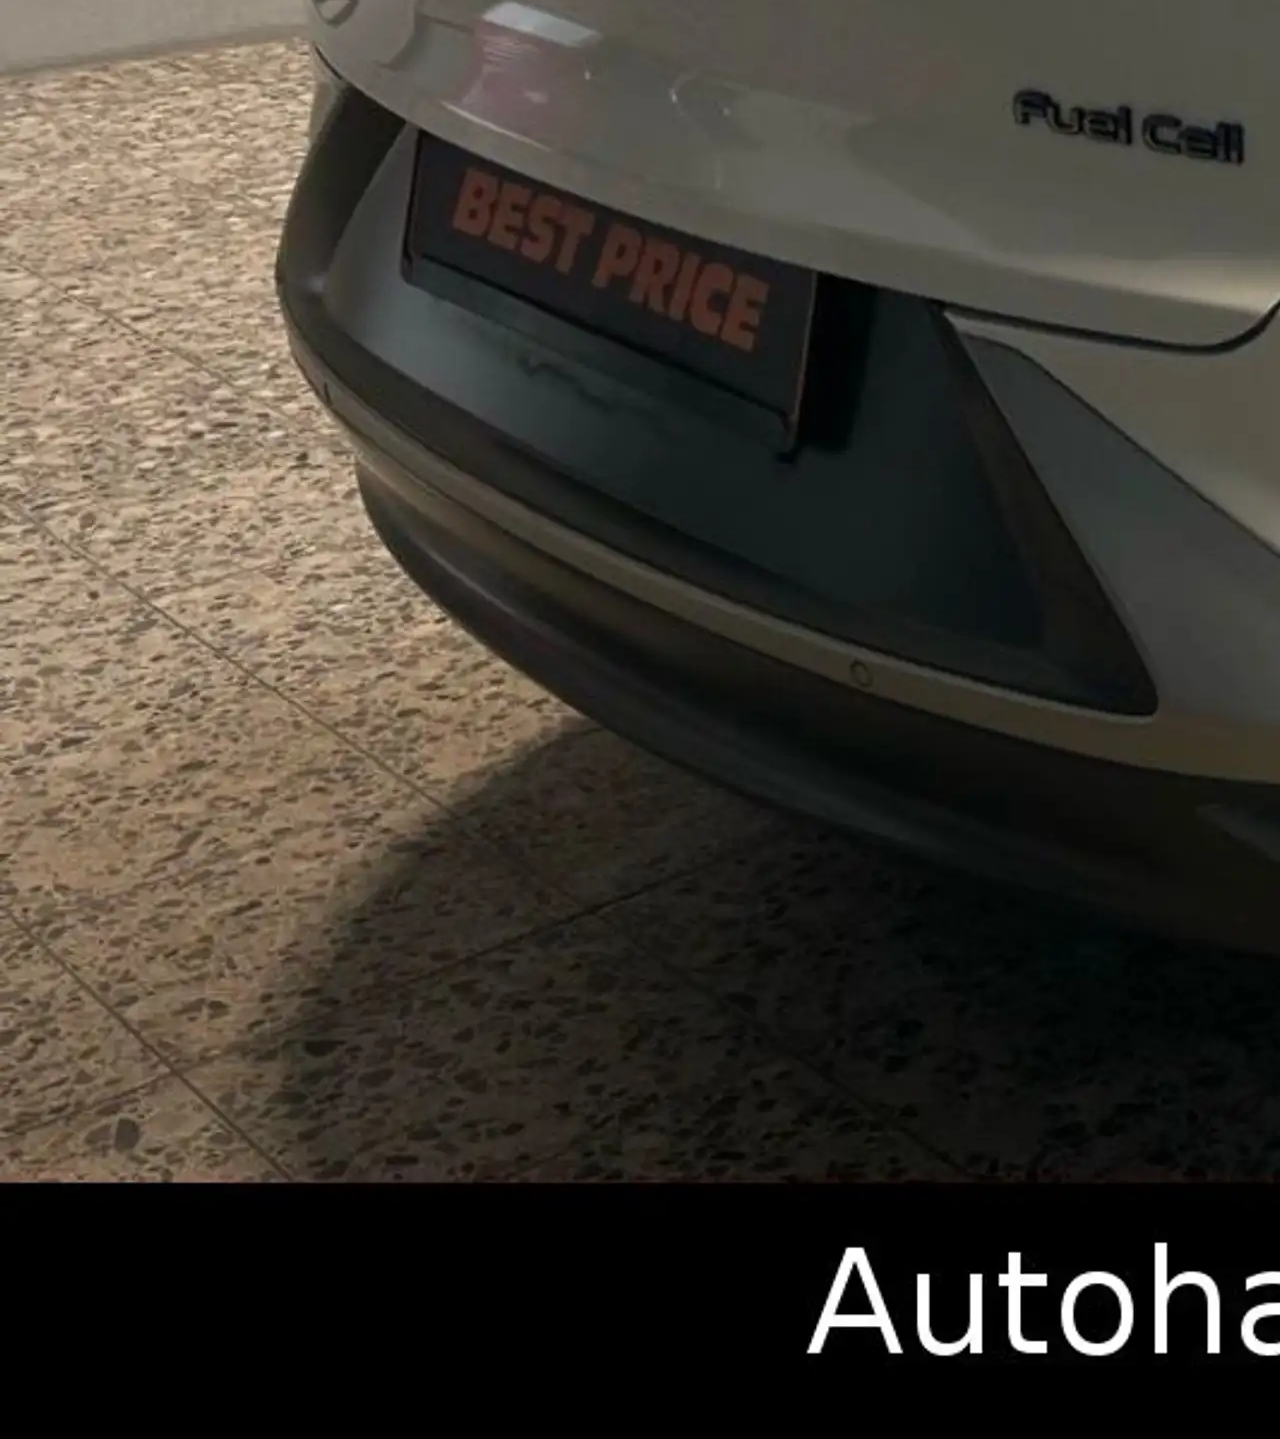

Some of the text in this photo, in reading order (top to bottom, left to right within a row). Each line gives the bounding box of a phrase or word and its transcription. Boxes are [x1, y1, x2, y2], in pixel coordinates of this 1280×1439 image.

[1012, 89, 1246, 166] Fuel Cell
[452, 168, 771, 353] BEST PRICE
